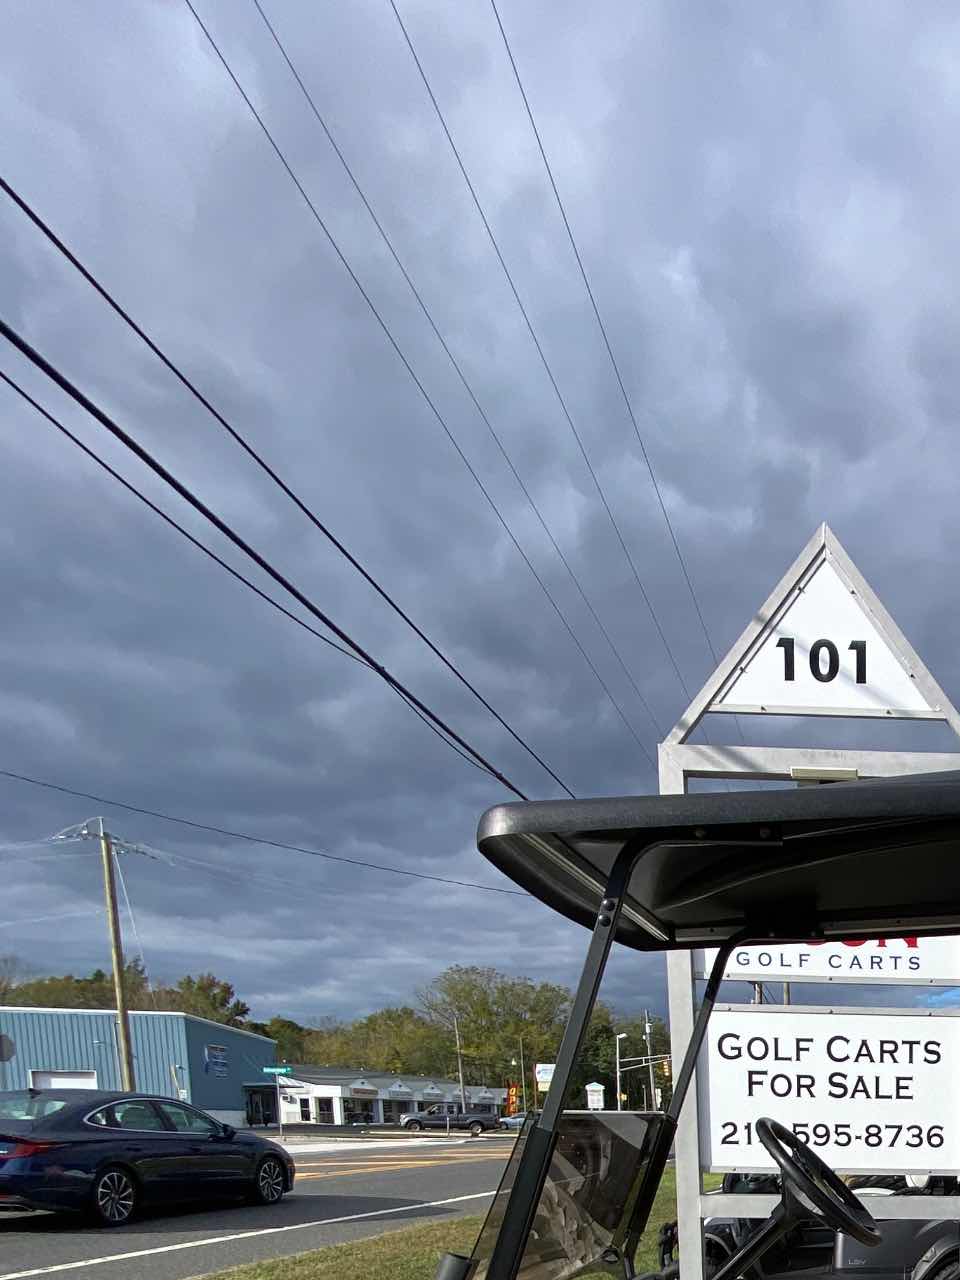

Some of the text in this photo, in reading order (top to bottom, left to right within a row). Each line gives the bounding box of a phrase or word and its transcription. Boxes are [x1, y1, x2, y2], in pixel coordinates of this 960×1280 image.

[775, 637, 867, 685] 101
[736, 951, 921, 971] GOLF CARTS
[717, 1032, 942, 1065] GOLF CARTS
[747, 1070, 914, 1100] FOR SALE
